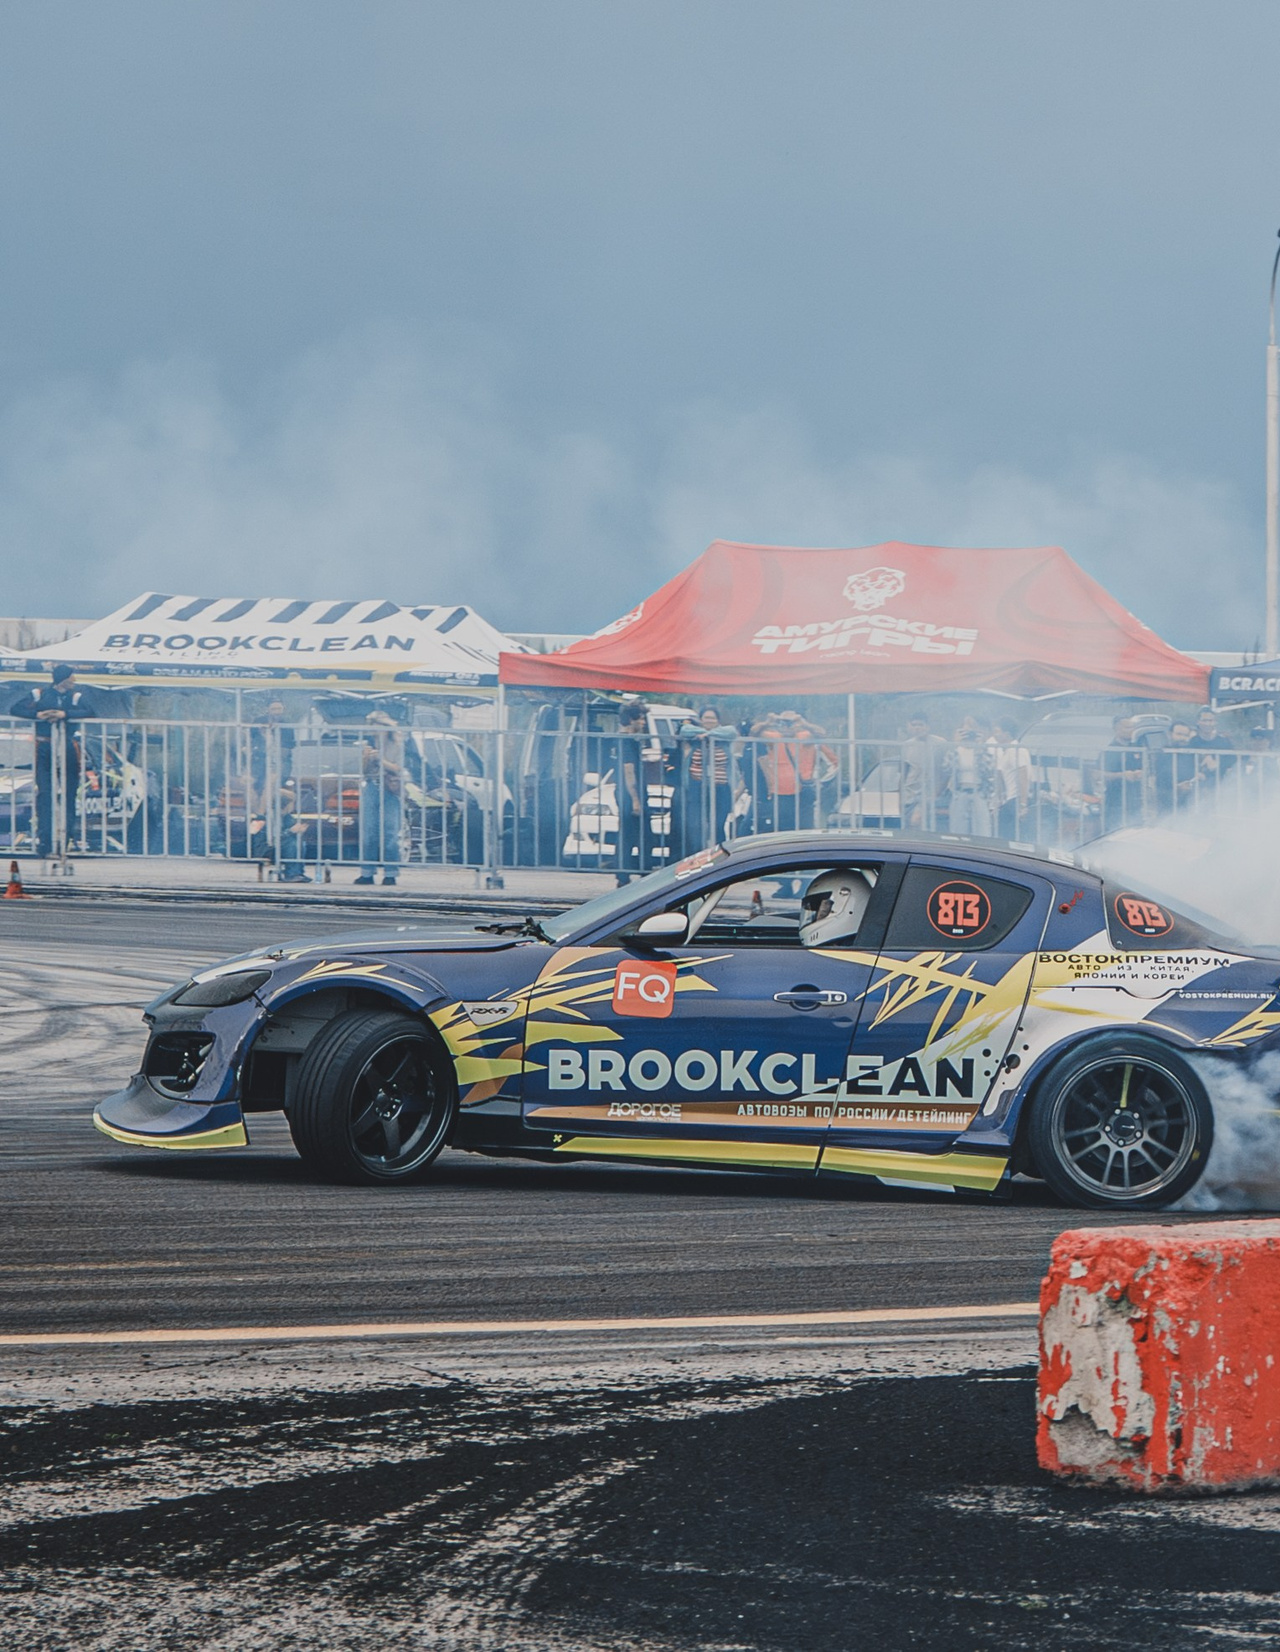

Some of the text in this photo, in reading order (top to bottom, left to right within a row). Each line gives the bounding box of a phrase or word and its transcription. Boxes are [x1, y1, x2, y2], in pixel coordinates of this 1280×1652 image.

[754, 614, 979, 640] АМУРСКИЕ
[103, 633, 415, 652] BROOKCLEAN
[751, 627, 975, 656] ТИГРЫ
[938, 892, 980, 926] 813
[1122, 898, 1167, 927] 813
[1039, 953, 1230, 967] ВОСТОКПРЕМИУМ
[617, 972, 671, 1004] FQ
[548, 1049, 975, 1098] BROOKCLEAN
[607, 1102, 682, 1117] ДОРОГОЕ
[737, 1104, 972, 1125] АВТОВОЗЫ ПО РОССИИ/ДЕТЕЙЛИНГ
